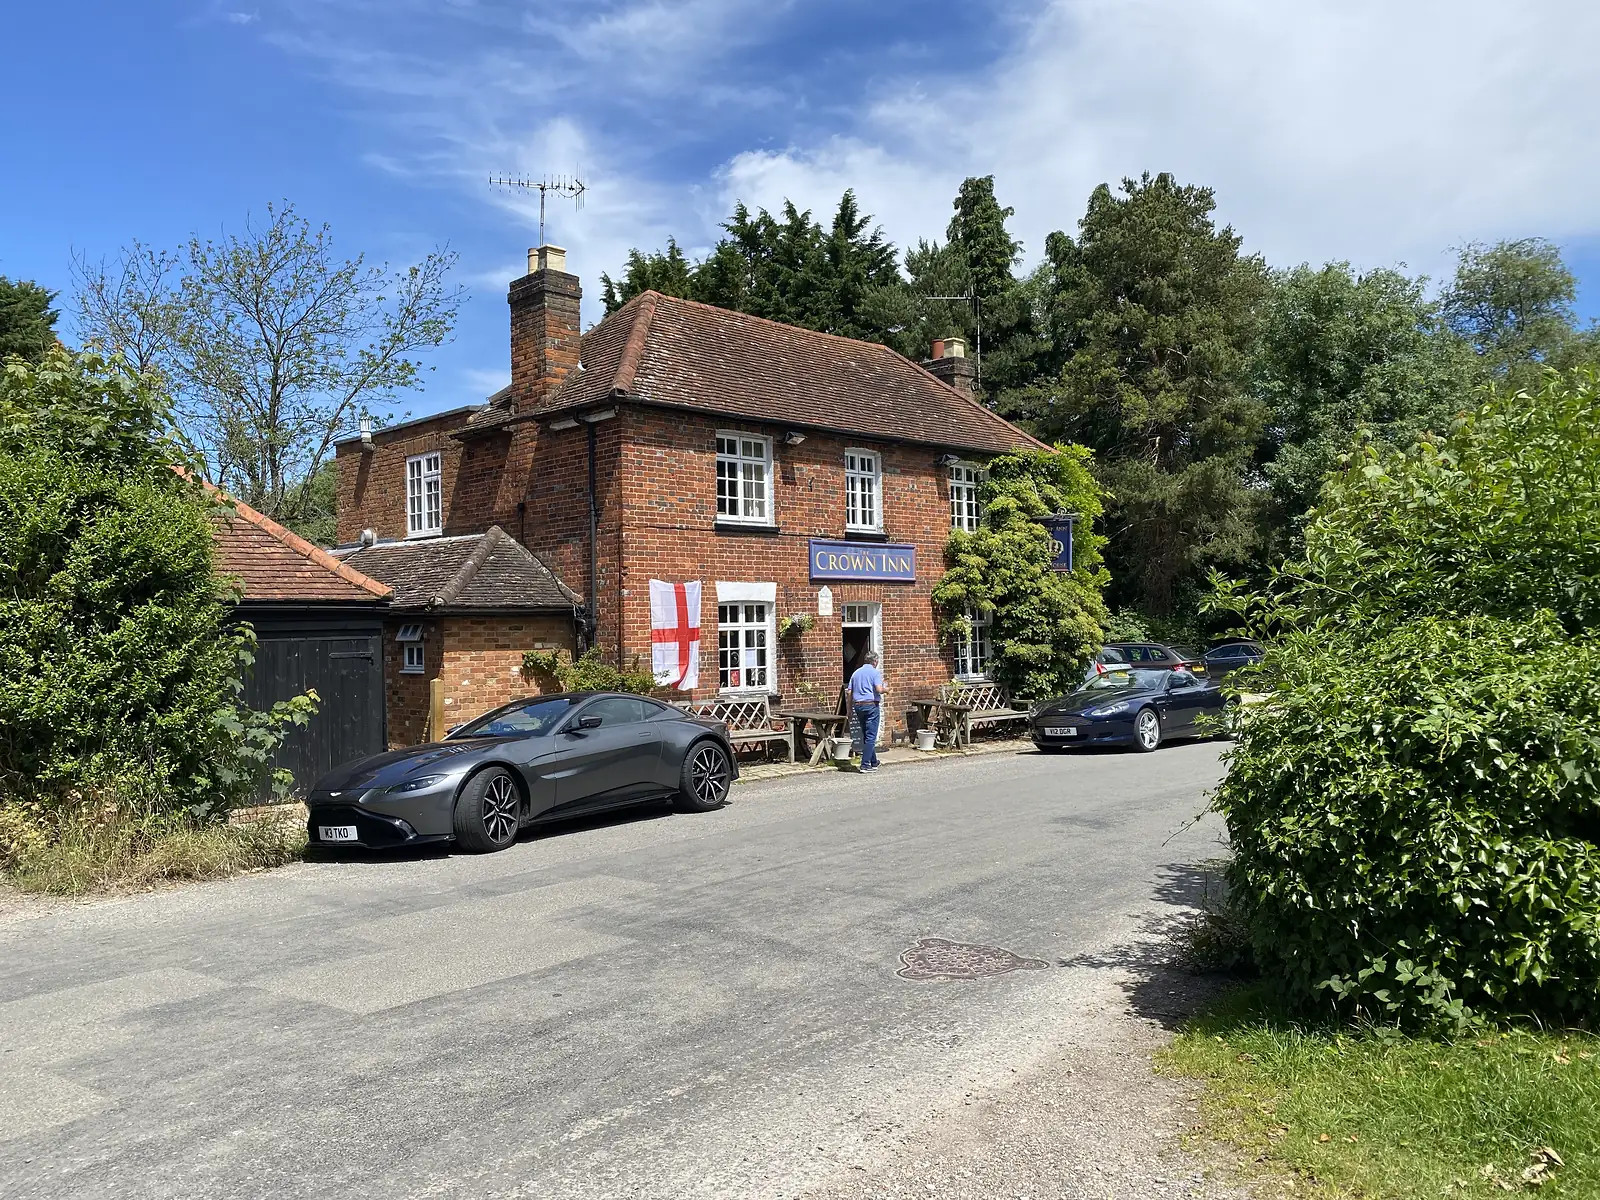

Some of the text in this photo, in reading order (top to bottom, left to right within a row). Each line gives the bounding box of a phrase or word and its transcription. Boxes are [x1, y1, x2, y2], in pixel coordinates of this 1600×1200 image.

[815, 550, 911, 573] CROWN INN
[333, 827, 348, 839] TKO
